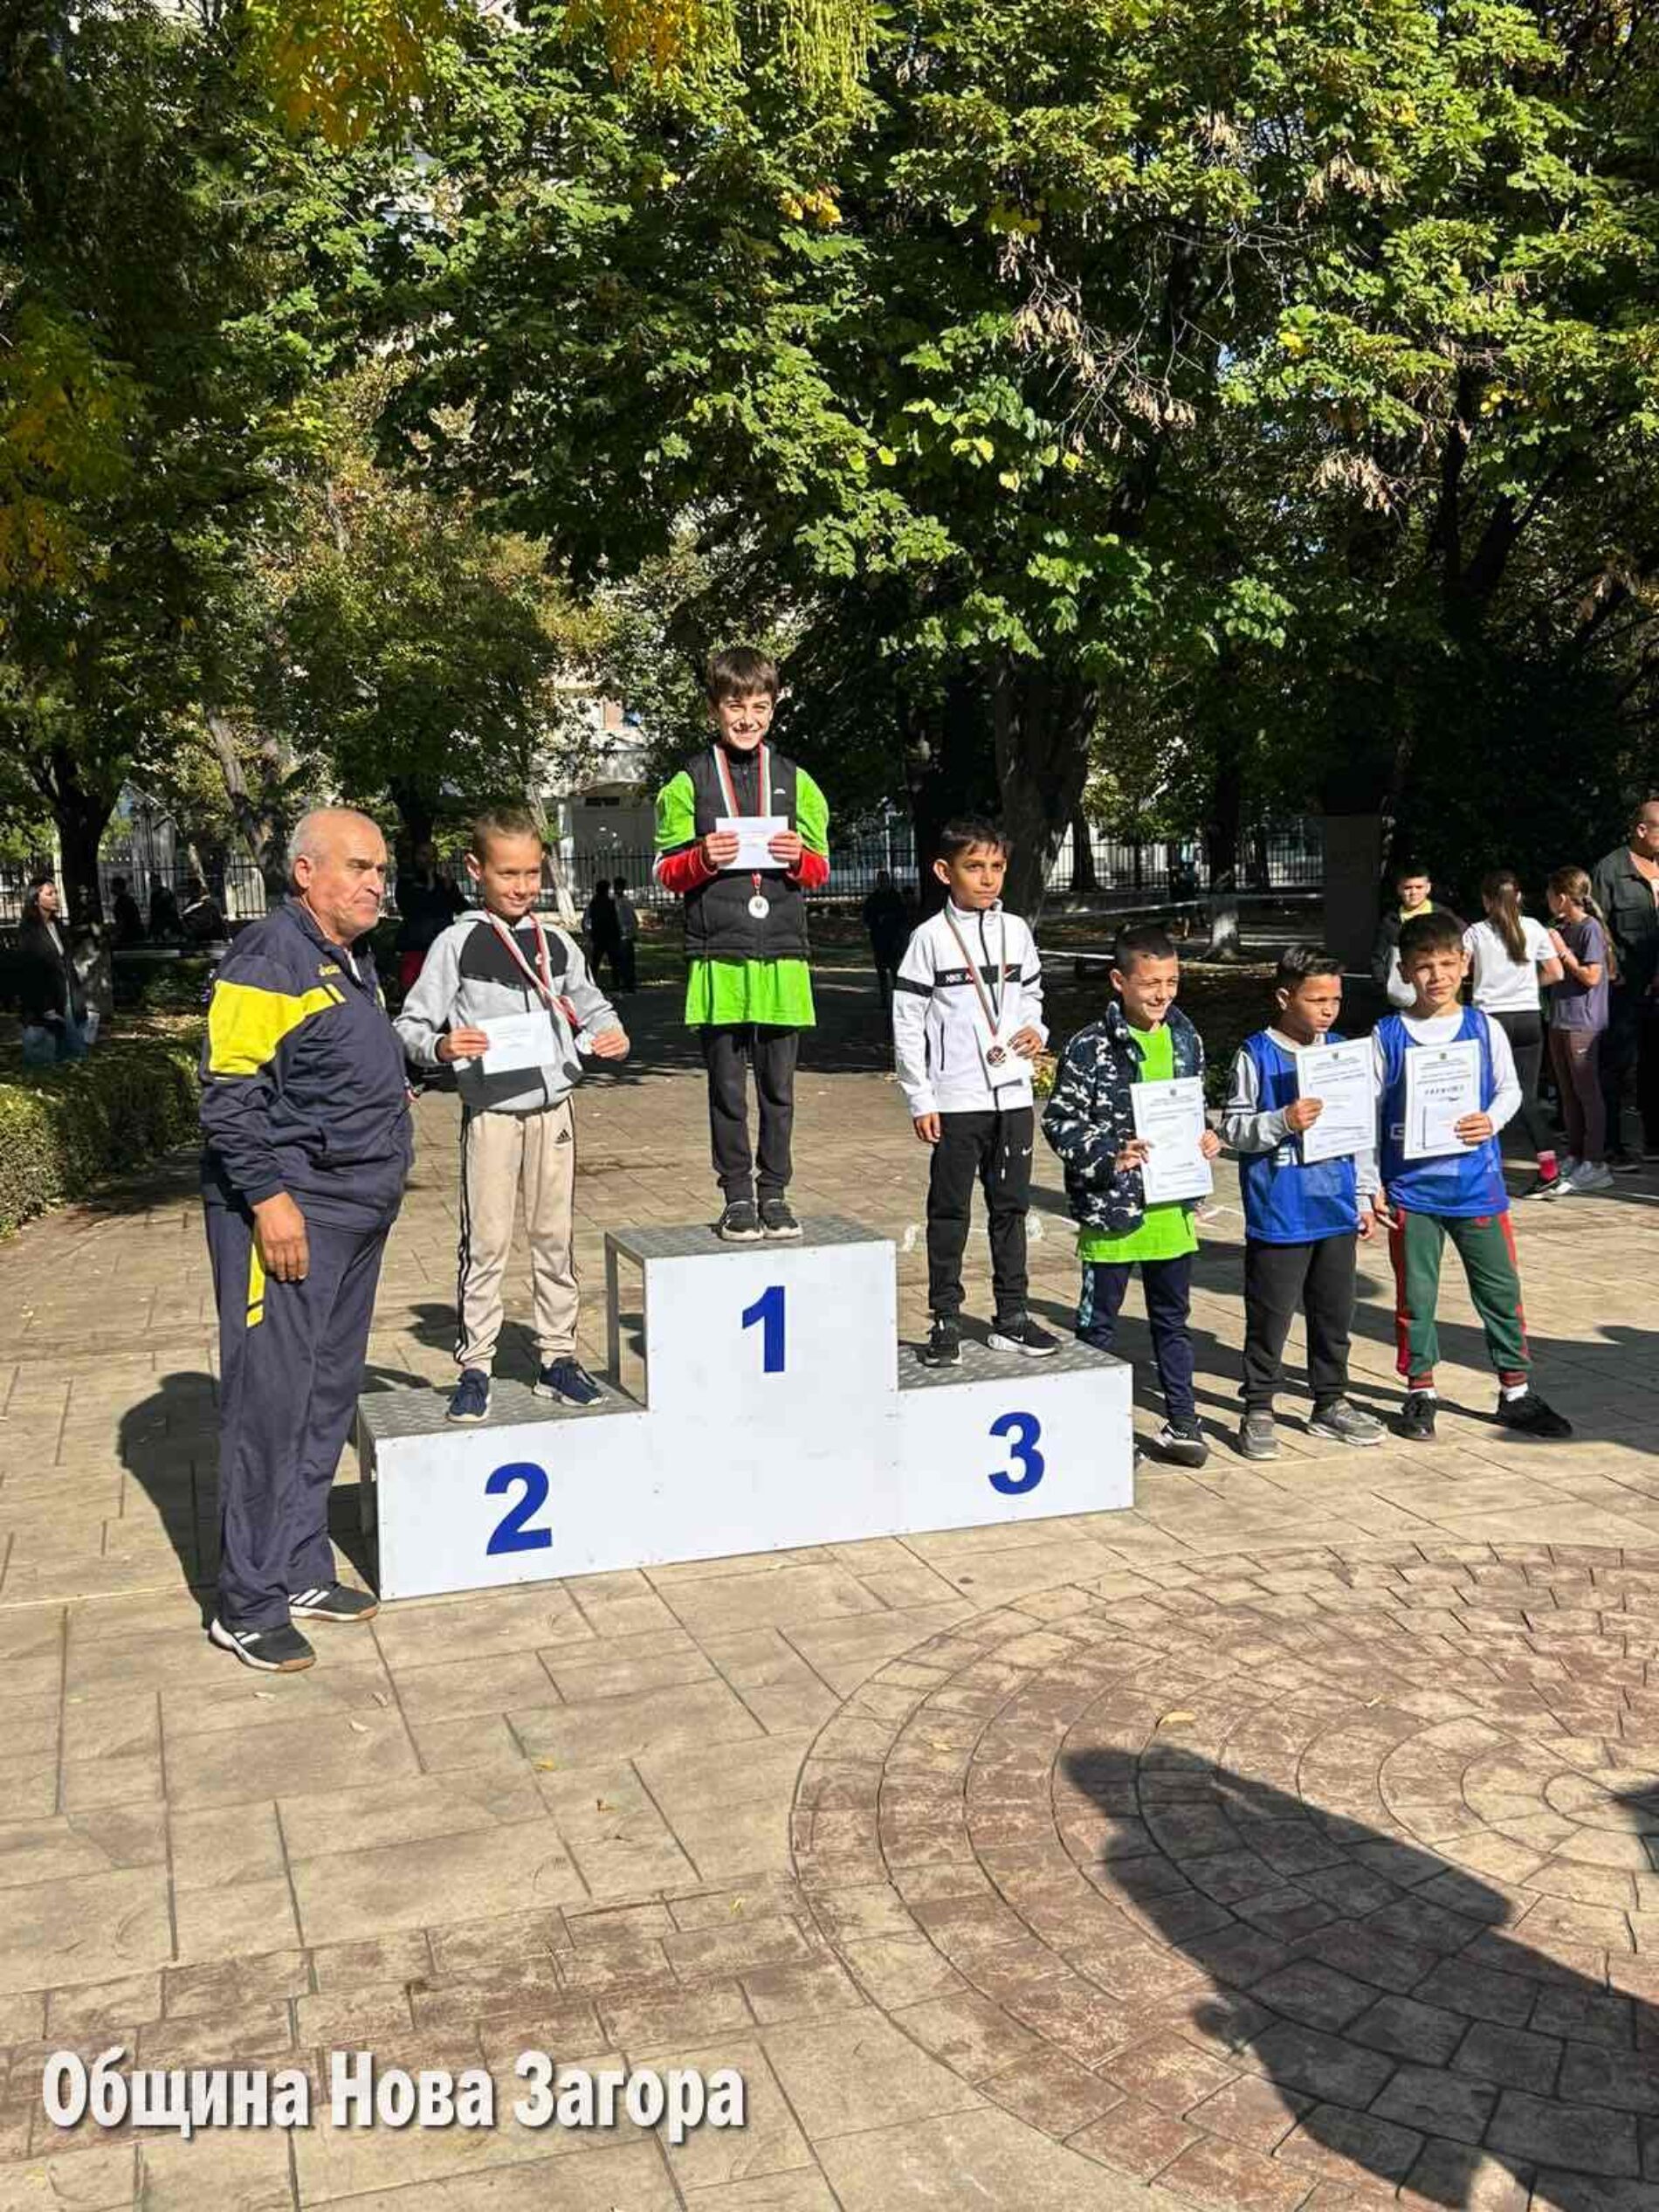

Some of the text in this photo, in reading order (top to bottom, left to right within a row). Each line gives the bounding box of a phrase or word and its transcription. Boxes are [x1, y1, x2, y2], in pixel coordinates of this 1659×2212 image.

[741, 1284, 787, 1374] 1
[988, 1411, 1045, 1497] 3
[485, 1461, 554, 1555] 2
